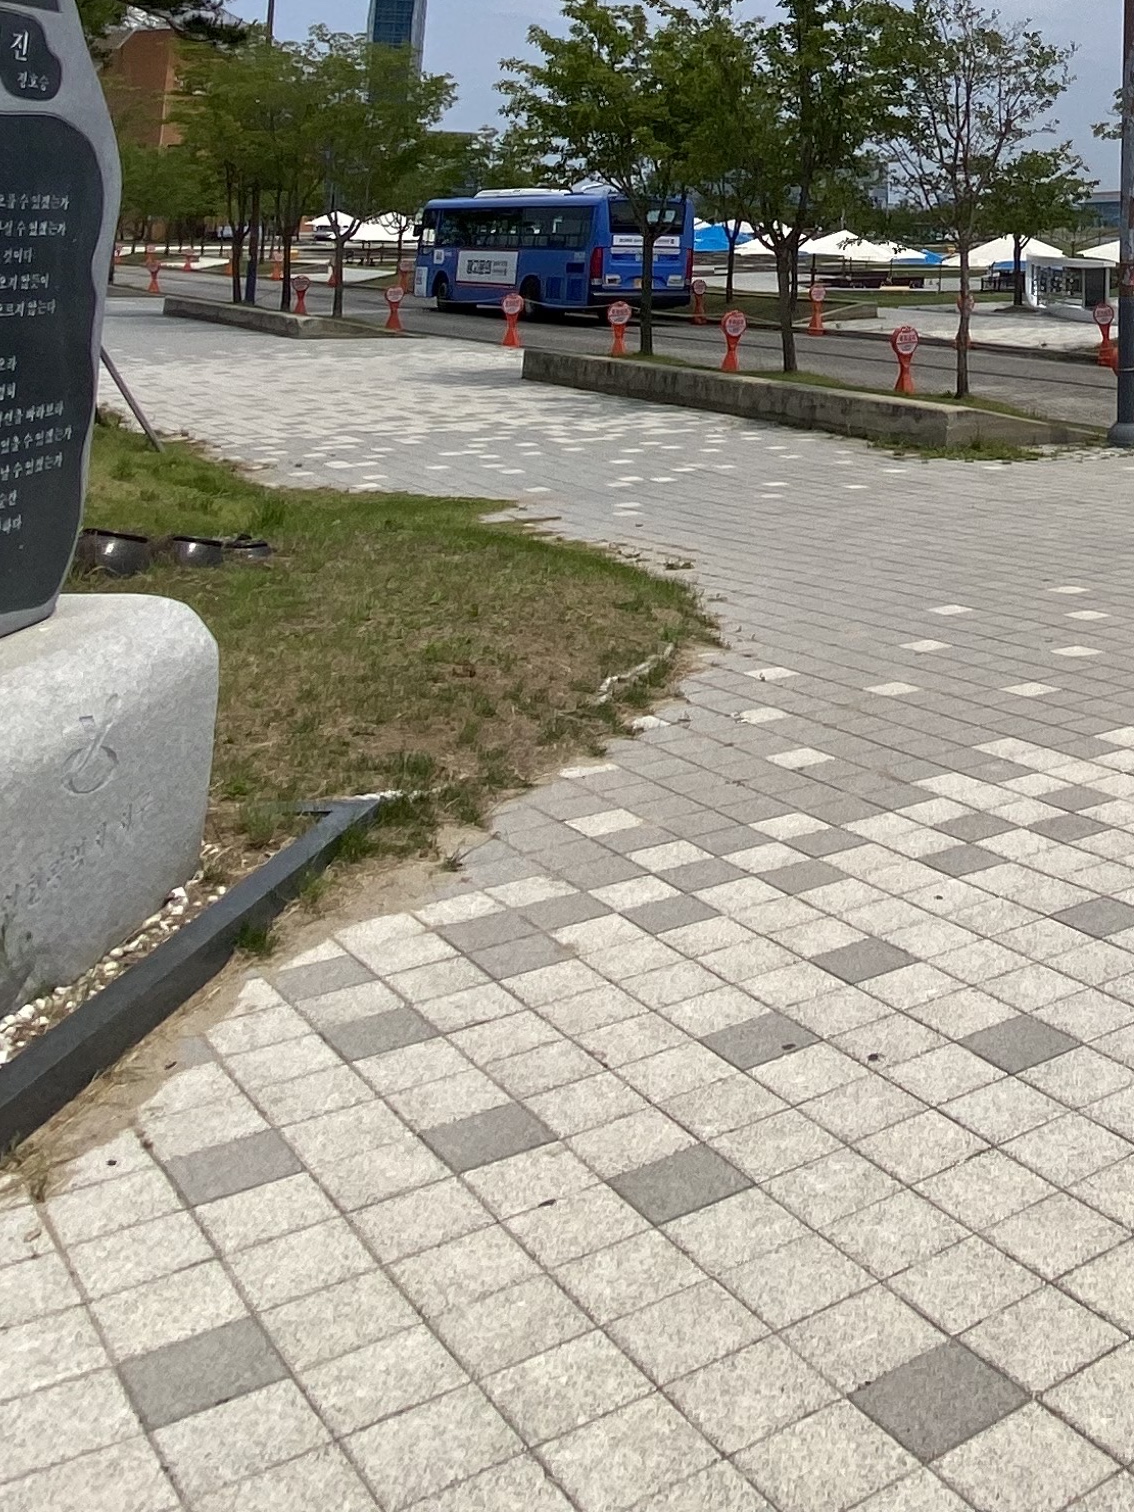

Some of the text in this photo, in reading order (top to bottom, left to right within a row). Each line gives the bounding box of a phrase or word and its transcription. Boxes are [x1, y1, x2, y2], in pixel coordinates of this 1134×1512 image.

[10, 30, 30, 61] 진
[31, 194, 70, 210] 있겠는가
[29, 220, 66, 236] 있겠는가
[3, 247, 33, 264] 것이다
[21, 273, 49, 290] 않듯이
[27, 299, 56, 316] 않는다
[26, 400, 64, 423] 바라보라
[24, 432, 33, 449] 수
[35, 425, 73, 447] 있겠는가
[13, 462, 23, 479] 수
[25, 452, 63, 476] 있겠는가
